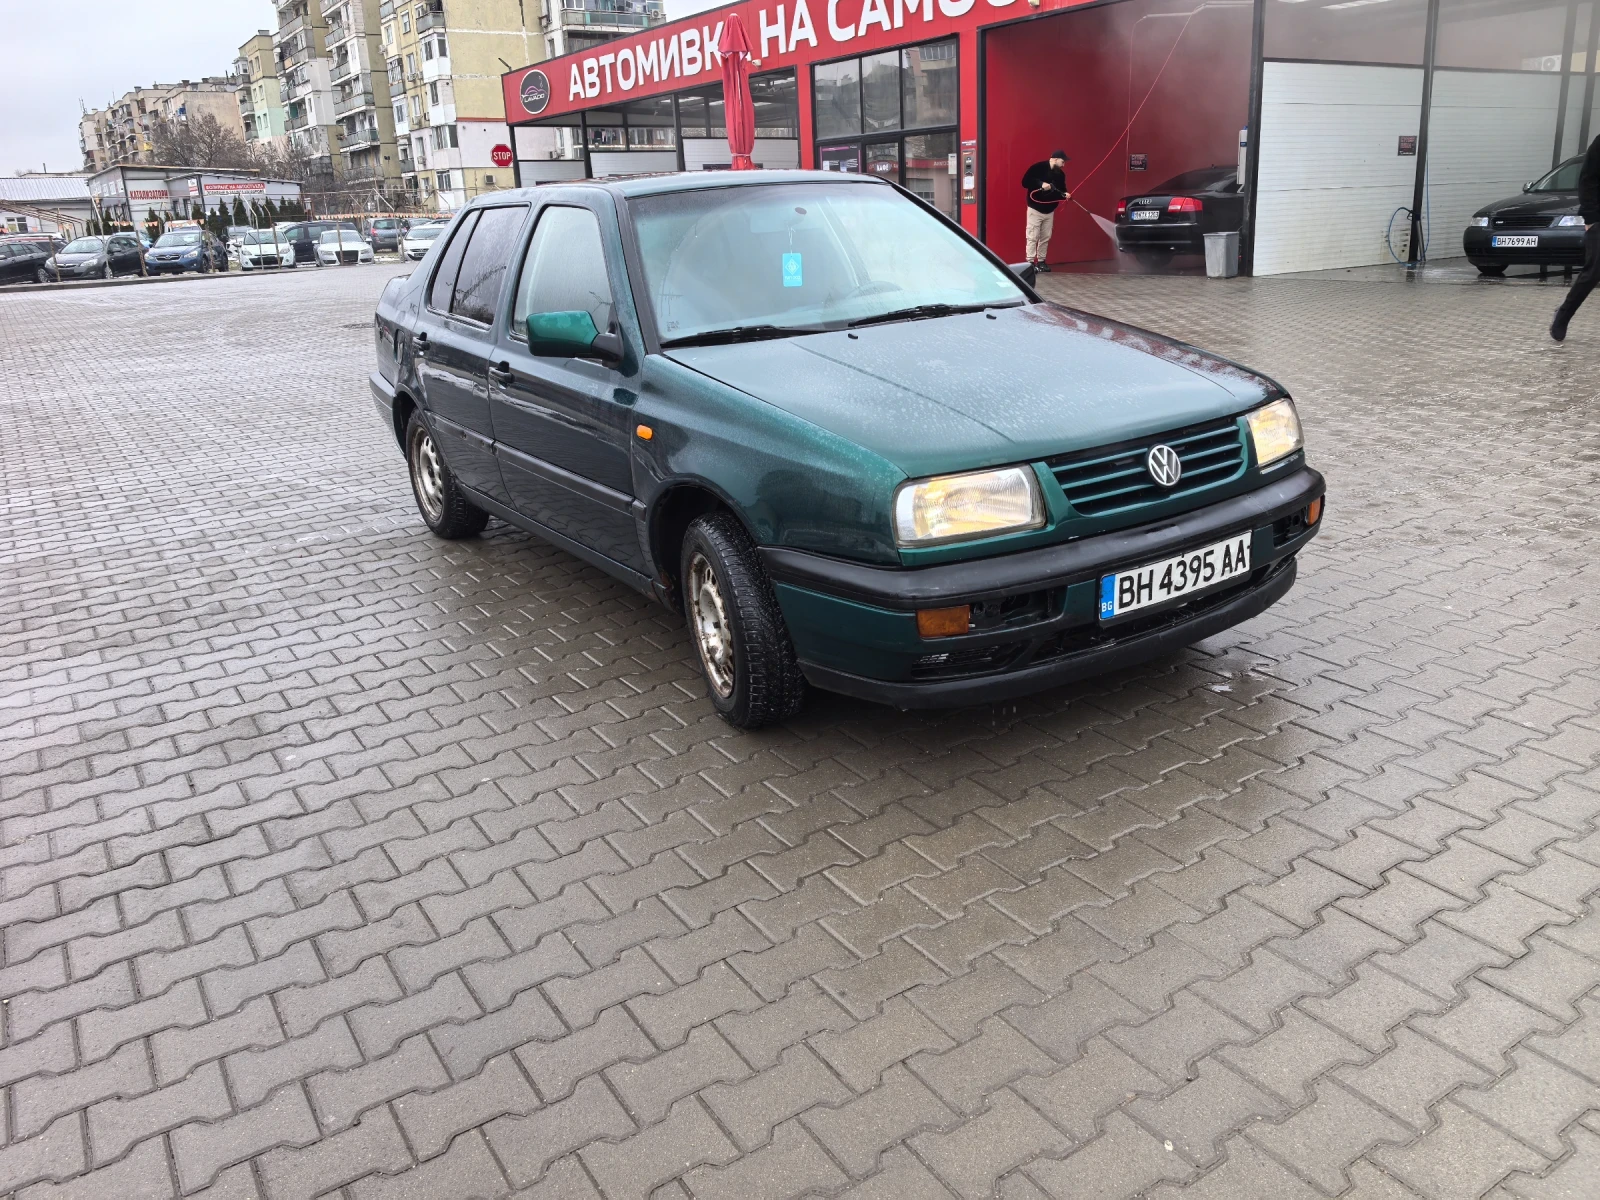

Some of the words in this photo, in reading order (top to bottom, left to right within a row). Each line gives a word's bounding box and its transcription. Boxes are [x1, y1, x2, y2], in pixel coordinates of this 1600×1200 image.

[569, 21, 752, 101] АВТОМИВК
[759, 0, 817, 58] НА
[493, 151, 511, 162] STOP
[1525, 237, 1537, 246] AH
[1118, 569, 1154, 609] BH
[1158, 549, 1215, 596] 4395
[1220, 539, 1247, 577] AA
[1101, 601, 1113, 612] BG
